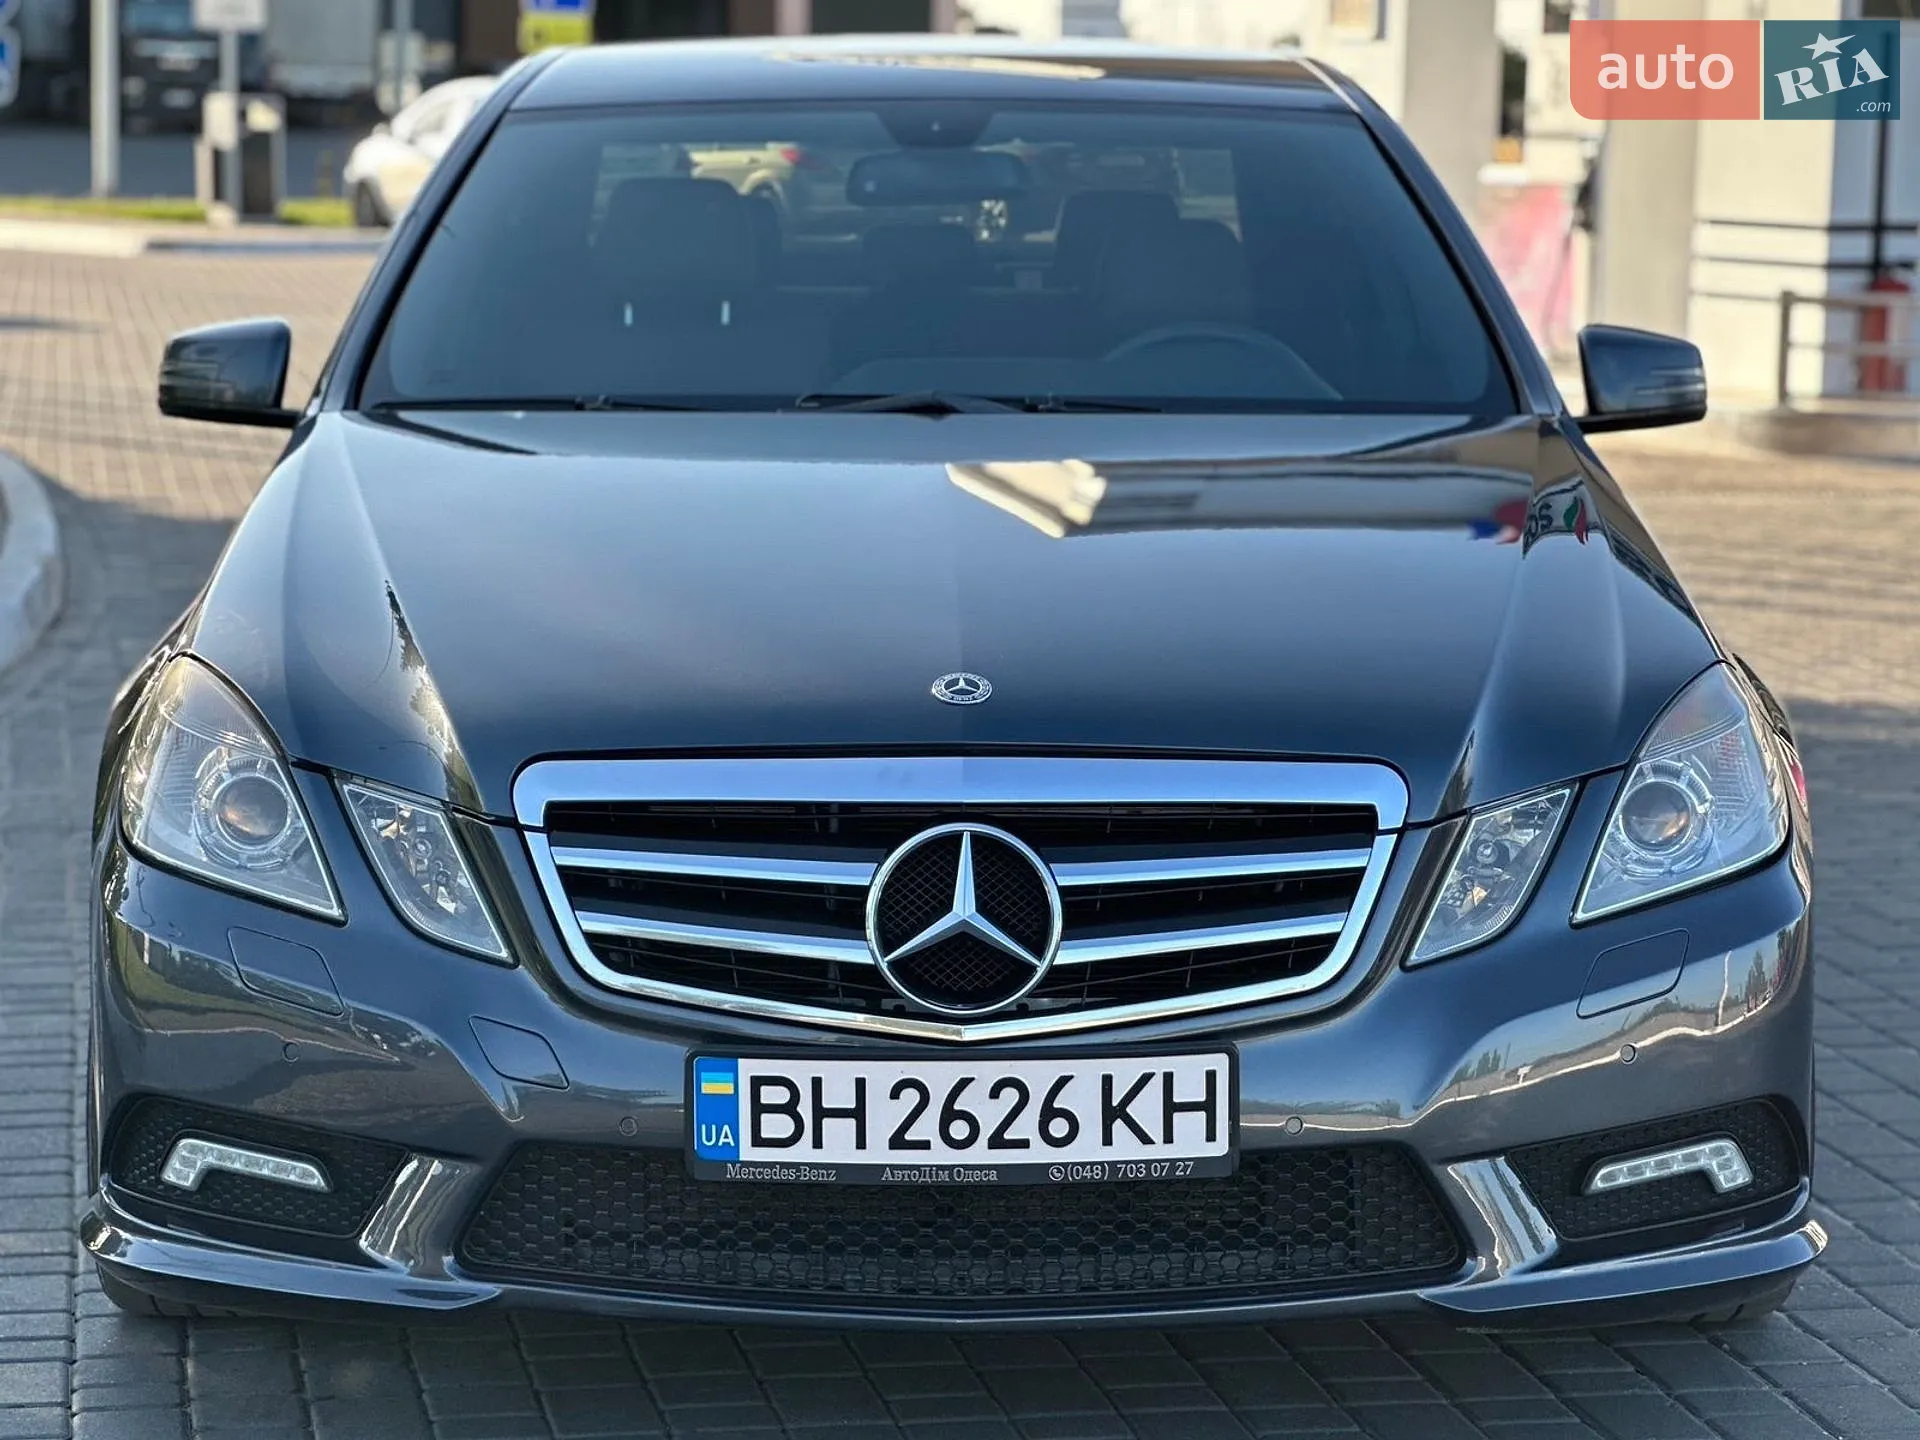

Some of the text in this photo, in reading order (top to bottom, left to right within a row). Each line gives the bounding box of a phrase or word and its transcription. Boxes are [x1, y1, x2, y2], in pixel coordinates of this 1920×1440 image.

[750, 1069, 1217, 1150] BH 2626 KH
[701, 1124, 735, 1147] UA
[726, 1163, 837, 1181] Mercedes-Benz
[881, 1167, 999, 1183] АвтоДім Одеса
[1067, 1161, 1194, 1181] (048) 703 07 27
